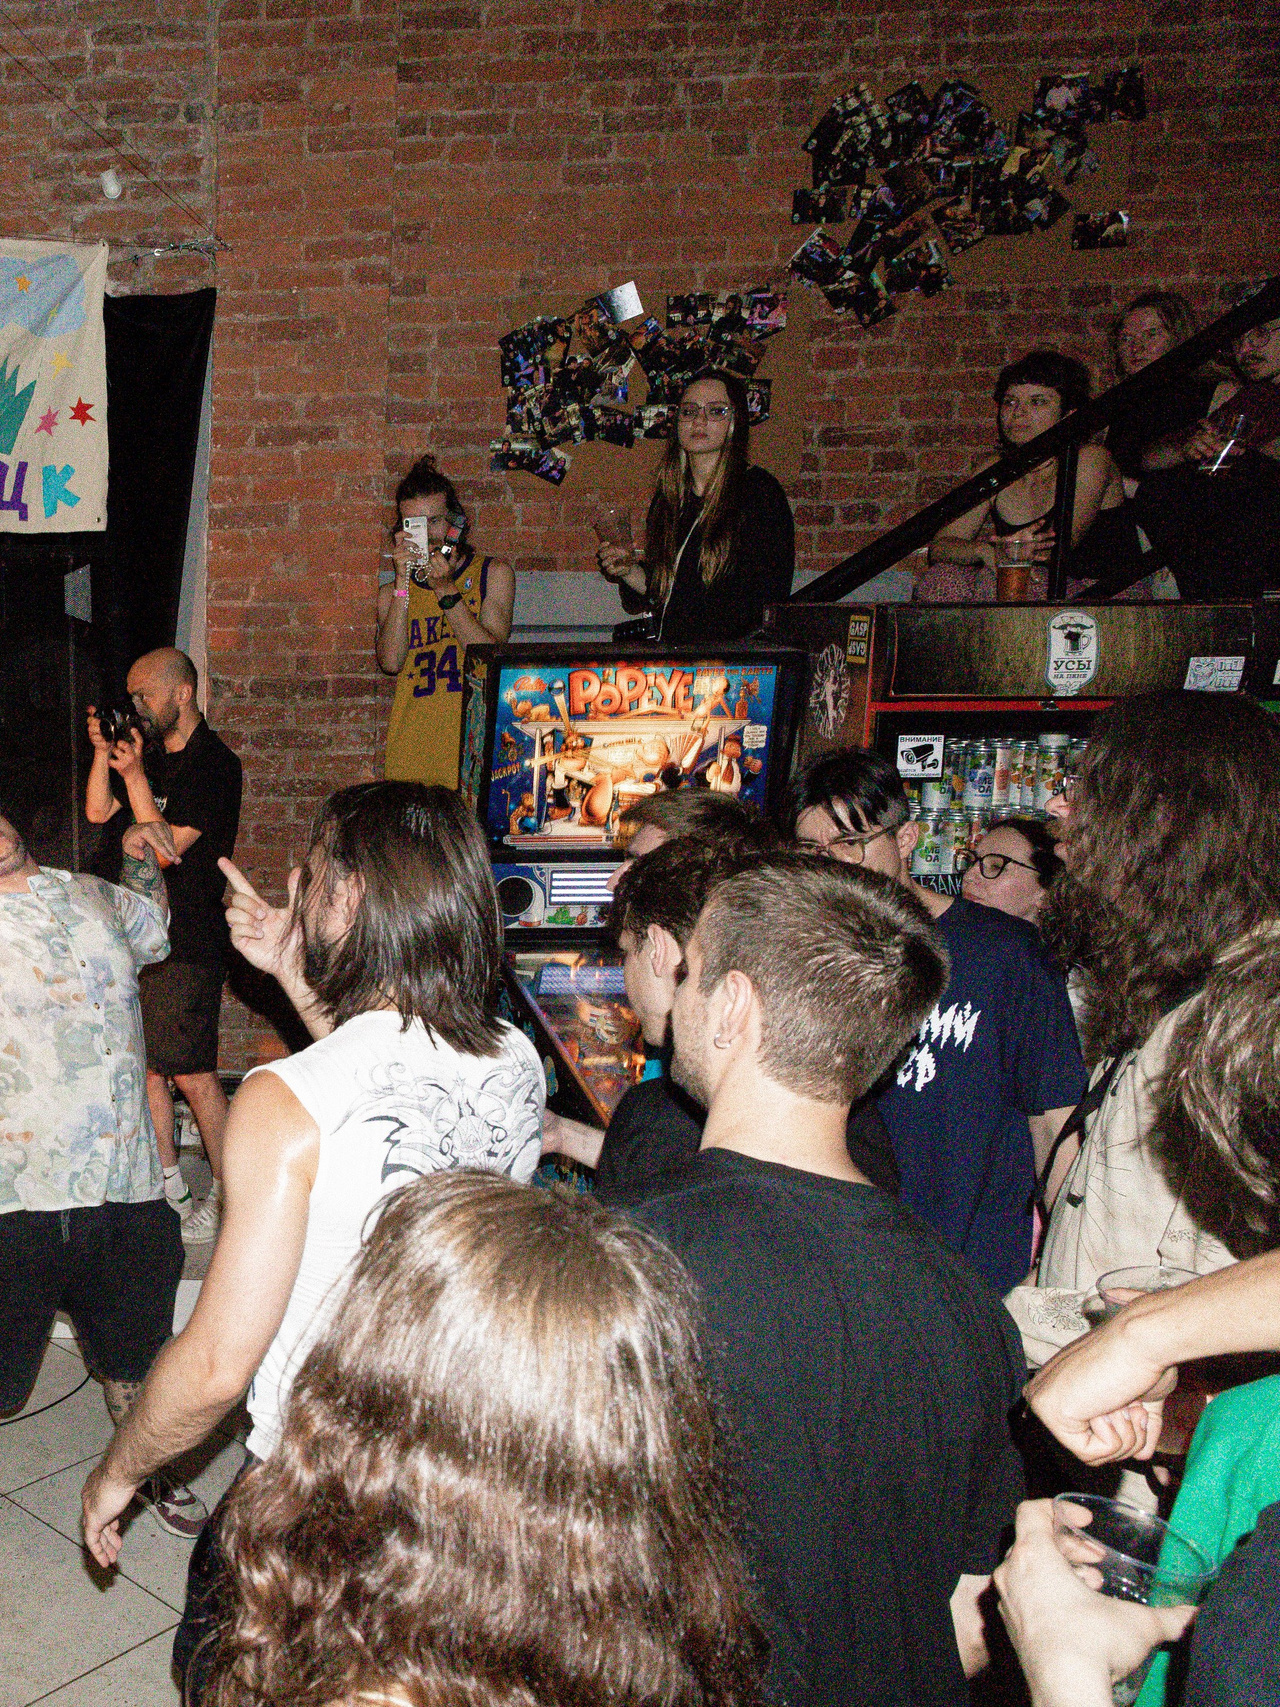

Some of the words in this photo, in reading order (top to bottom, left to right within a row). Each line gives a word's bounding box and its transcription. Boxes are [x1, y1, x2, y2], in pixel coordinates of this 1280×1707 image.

[408, 614, 457, 650] AKE
[849, 621, 868, 636] GASP
[413, 645, 462, 698] 34
[741, 667, 773, 677] EARTH
[1053, 659, 1092, 671] УСЫ
[568, 666, 695, 716] POPEYE
[490, 761, 521, 782] JACKPOT
[925, 846, 941, 854] ME
[925, 855, 940, 863] DA
[911, 874, 963, 896] ЕЗАЛК
